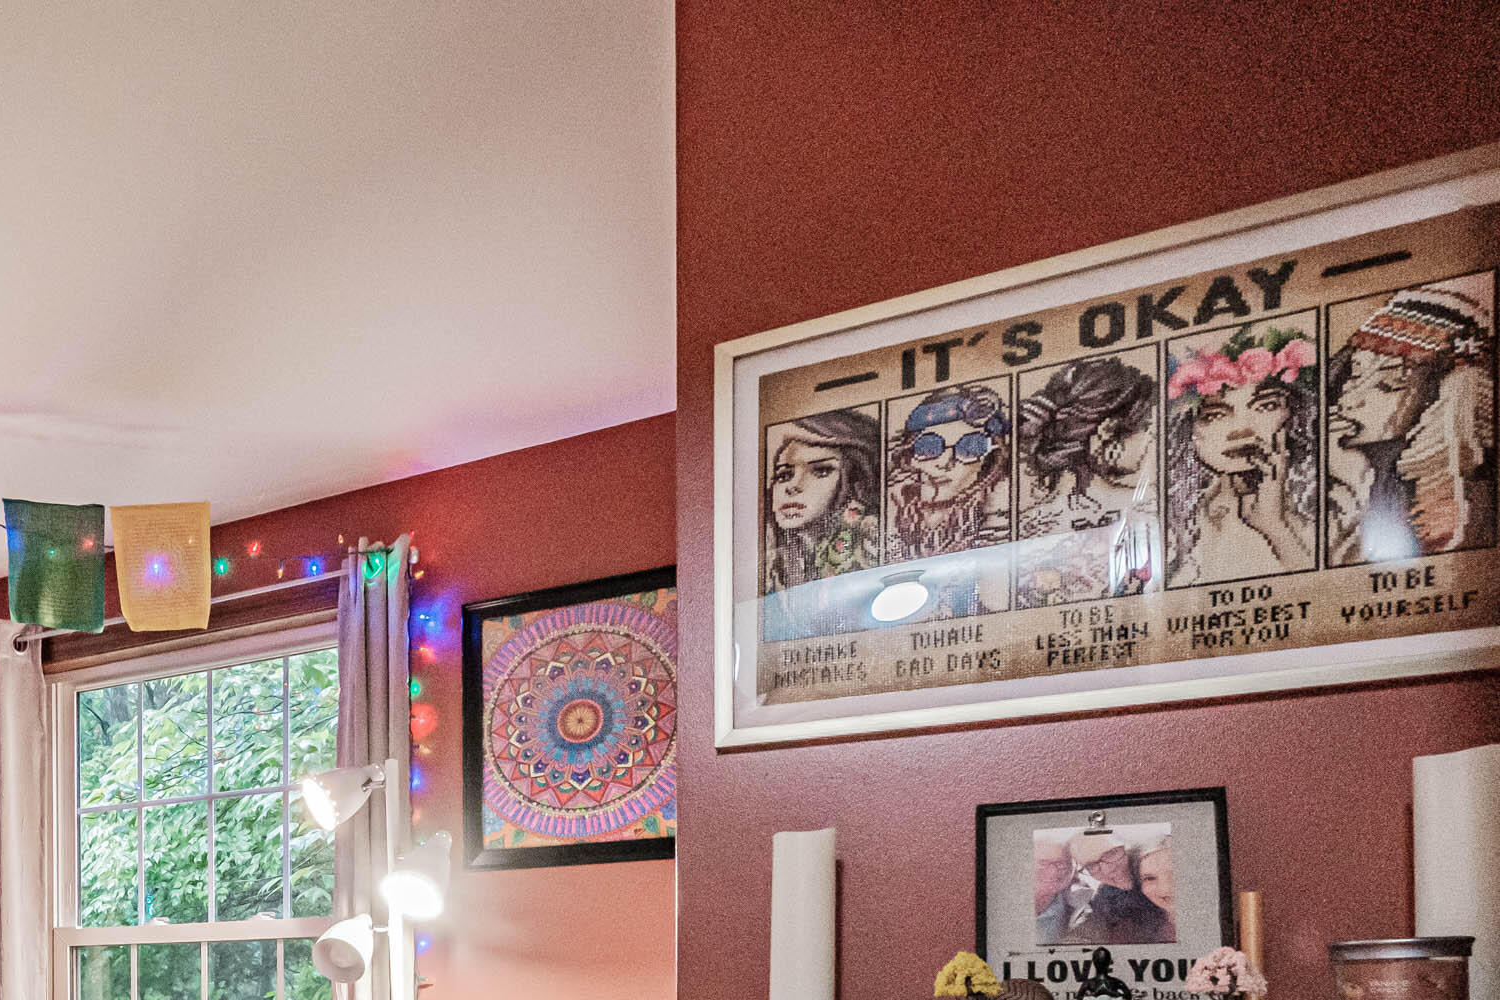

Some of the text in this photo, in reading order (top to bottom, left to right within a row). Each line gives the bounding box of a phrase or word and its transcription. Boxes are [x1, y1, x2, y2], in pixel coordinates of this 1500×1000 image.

[900, 258, 1300, 390] IT'S OKAY
[1368, 565, 1436, 593] TO BE
[1208, 584, 1273, 607] TO DO
[1341, 590, 1478, 624] YOURSELF
[1059, 605, 1113, 629] TO BE
[1167, 601, 1311, 634] WHATS BEST
[910, 631, 930, 651] TO
[1036, 622, 1149, 650] LESS THAN
[1192, 623, 1289, 650] FOR YOU
[781, 640, 857, 666] TO MAKE
[896, 647, 1001, 678] BAD DAYS
[1047, 642, 1136, 667] PERFECT
[774, 661, 867, 689] MISTAKES
[1027, 959, 1113, 983] LOV
[1153, 987, 1200, 1000] back
